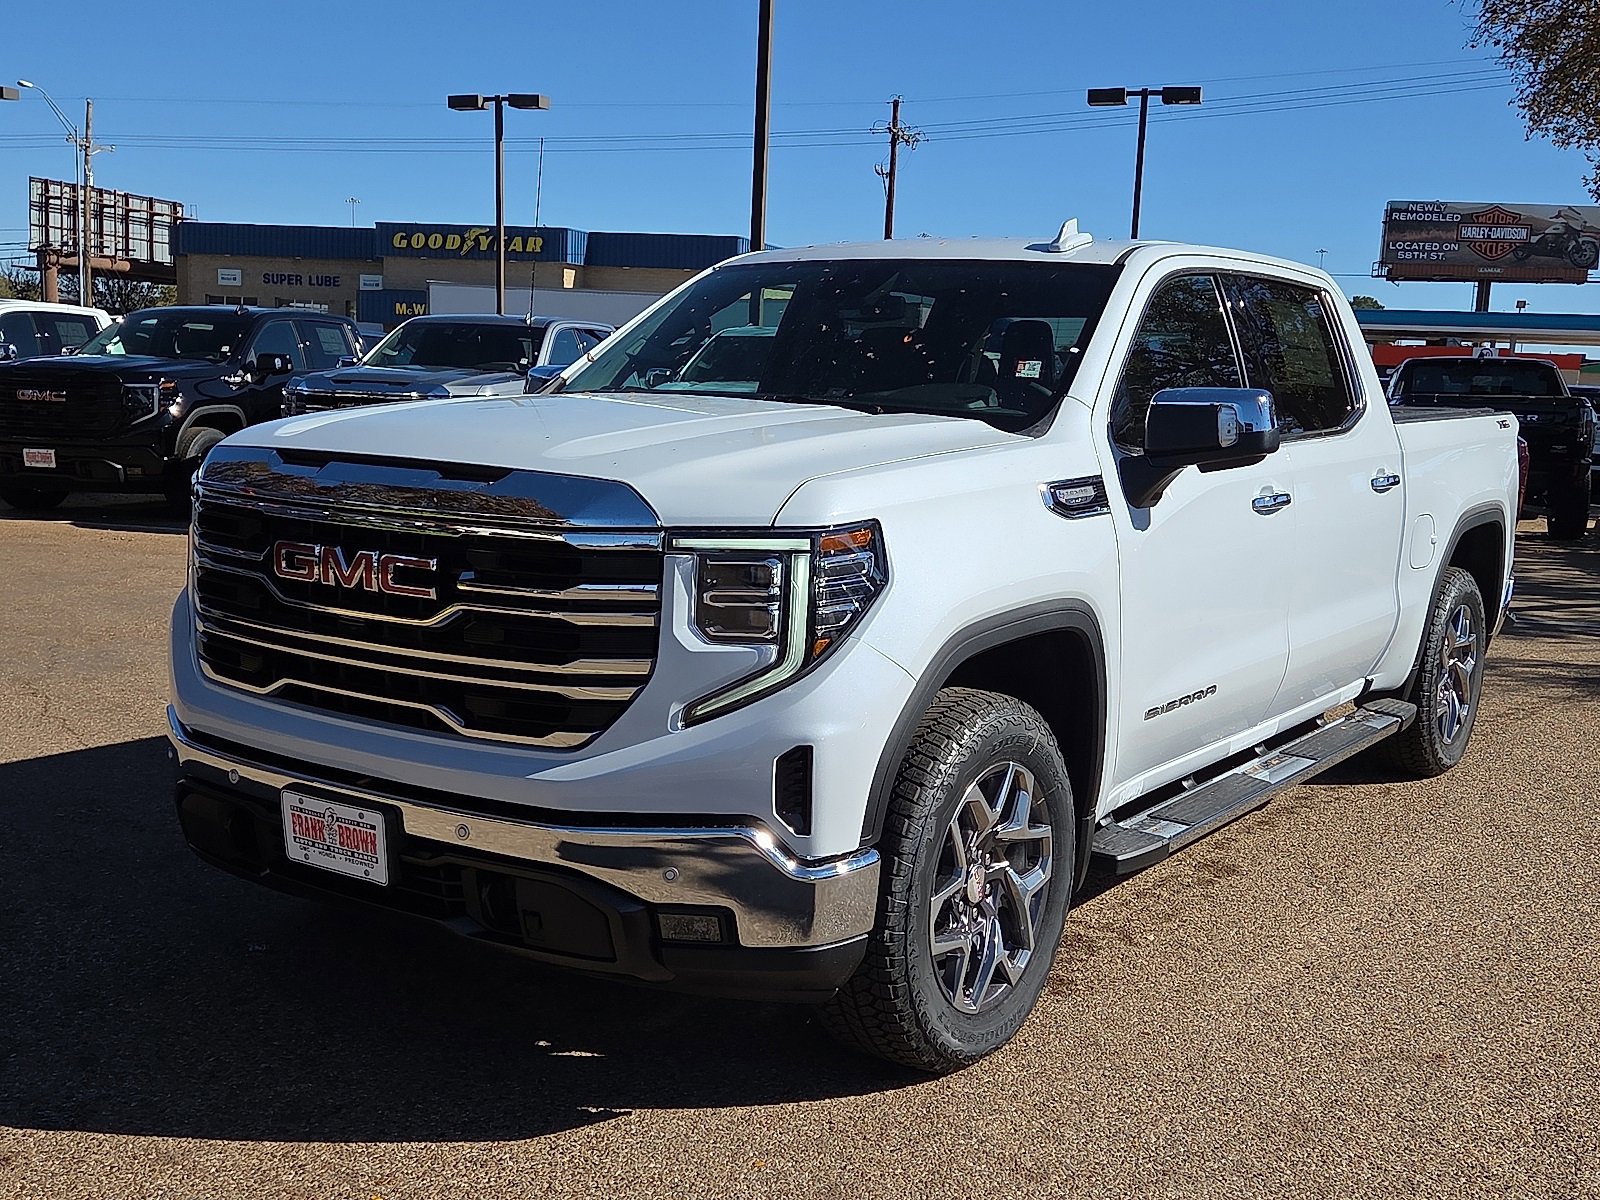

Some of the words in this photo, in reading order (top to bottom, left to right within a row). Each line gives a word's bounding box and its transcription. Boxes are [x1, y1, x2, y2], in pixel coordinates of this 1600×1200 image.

[1409, 204, 1447, 212] NEWLY
[1392, 213, 1461, 222] REMODELED
[1479, 214, 1517, 224] MOTOR
[1461, 227, 1528, 240] HARLEY-DAVIDSON
[393, 232, 543, 253] GOODYAR
[1389, 242, 1441, 251] LOCATED
[1444, 243, 1459, 251] ON
[1398, 251, 1427, 260] 58TH
[1475, 242, 1510, 257] CYCLES
[262, 273, 303, 286] SUPER
[308, 275, 341, 287] LUBE
[395, 302, 428, 315] McW
[16, 389, 66, 402] GMC
[274, 540, 437, 600] GMC
[1144, 684, 1217, 721] SIERRA
[290, 812, 327, 843] FRANK
[337, 824, 378, 856] BROWN
